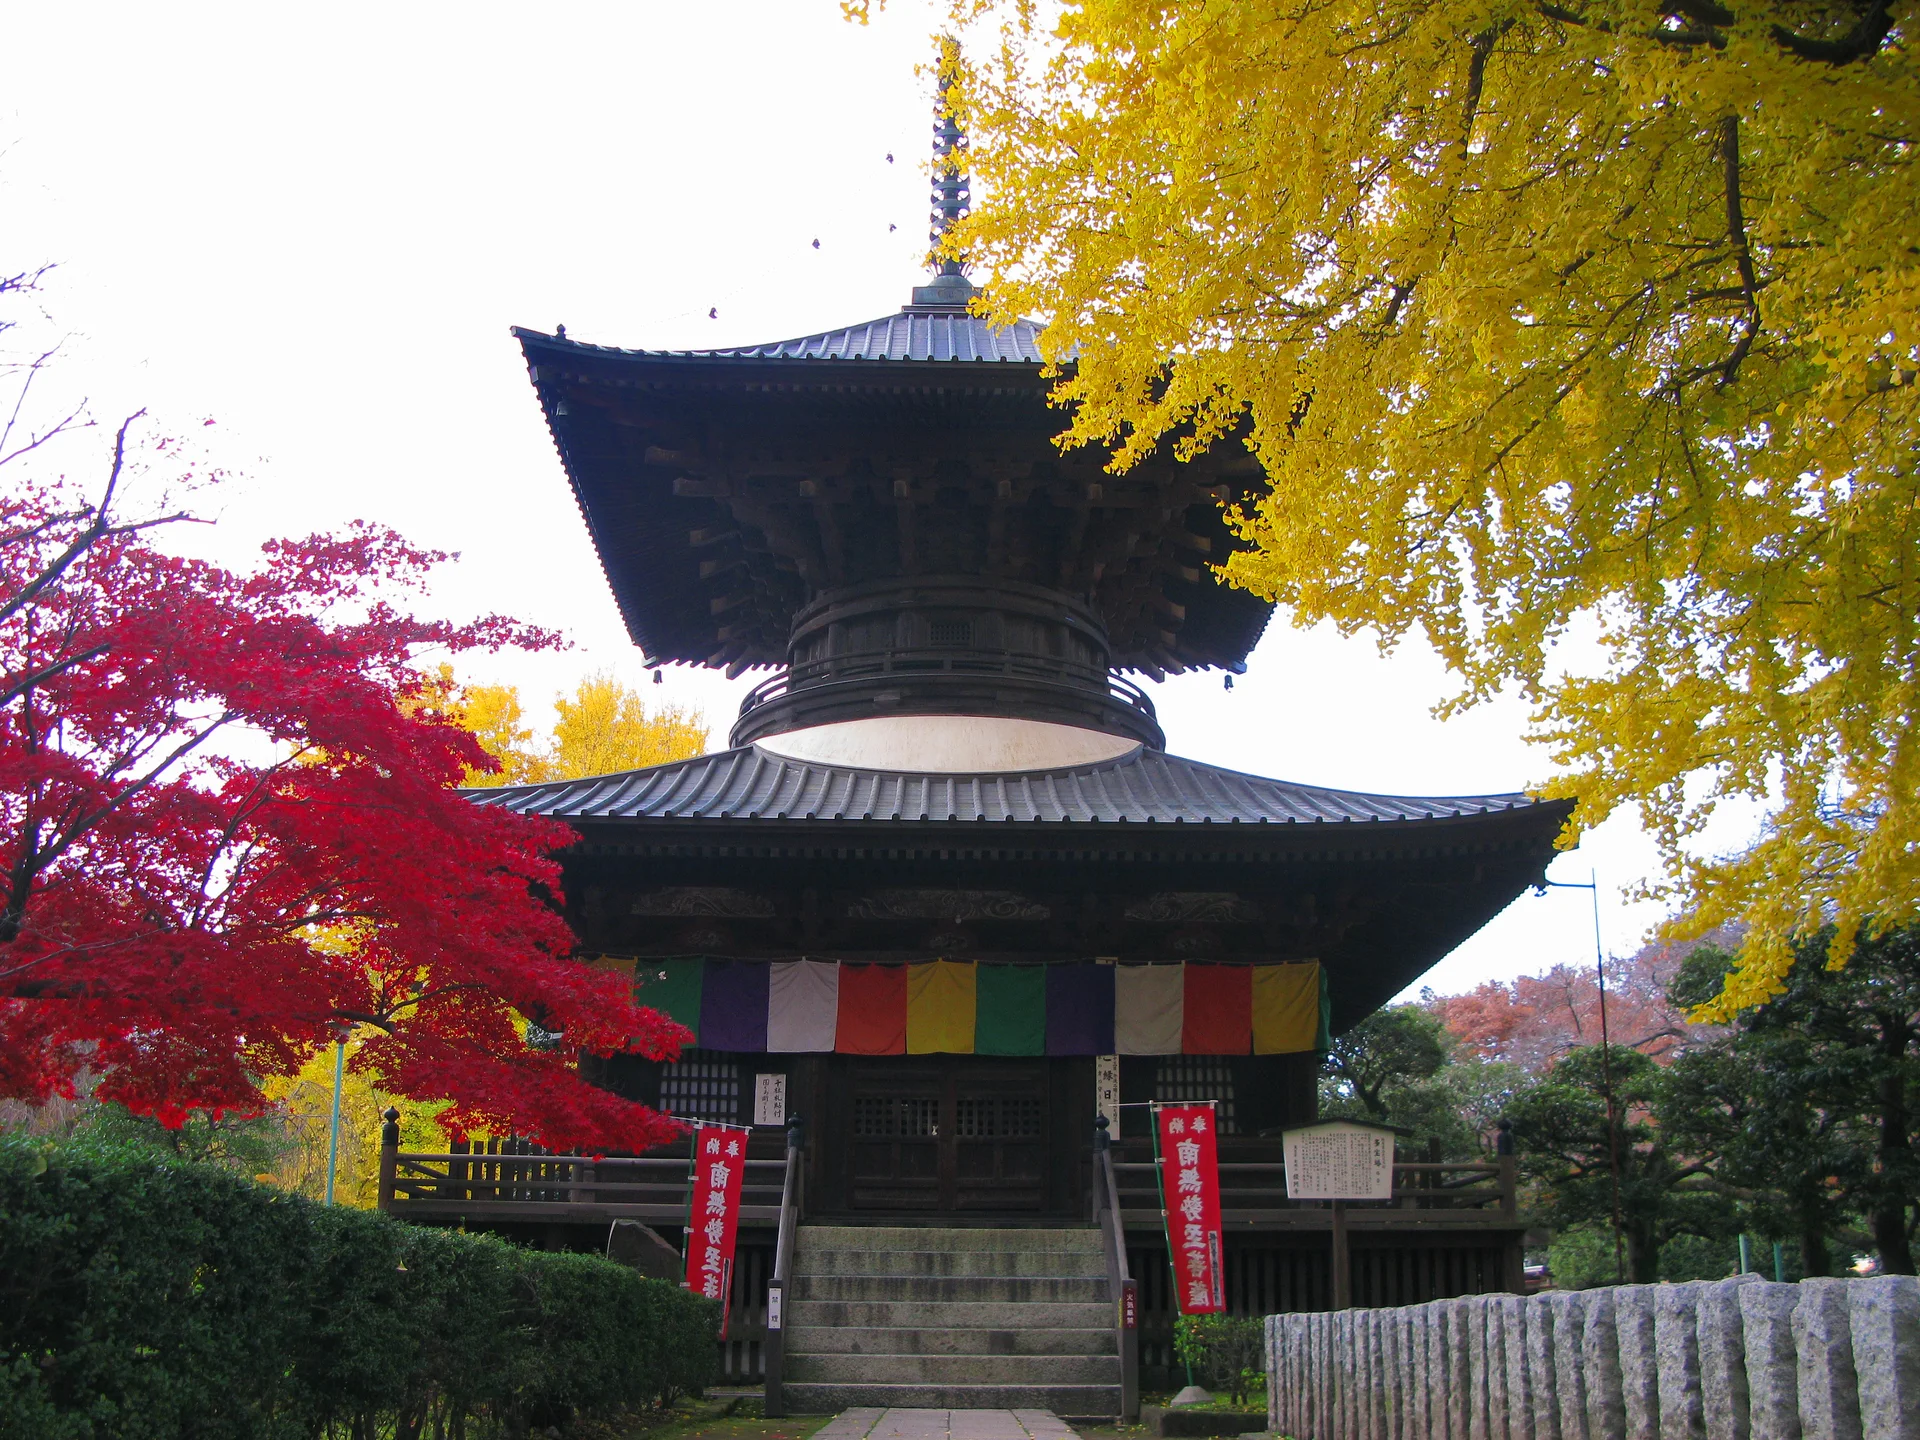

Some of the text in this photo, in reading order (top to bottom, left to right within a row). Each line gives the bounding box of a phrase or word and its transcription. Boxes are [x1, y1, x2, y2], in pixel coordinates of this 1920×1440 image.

[773, 1079, 783, 1118] 千社札貼付
